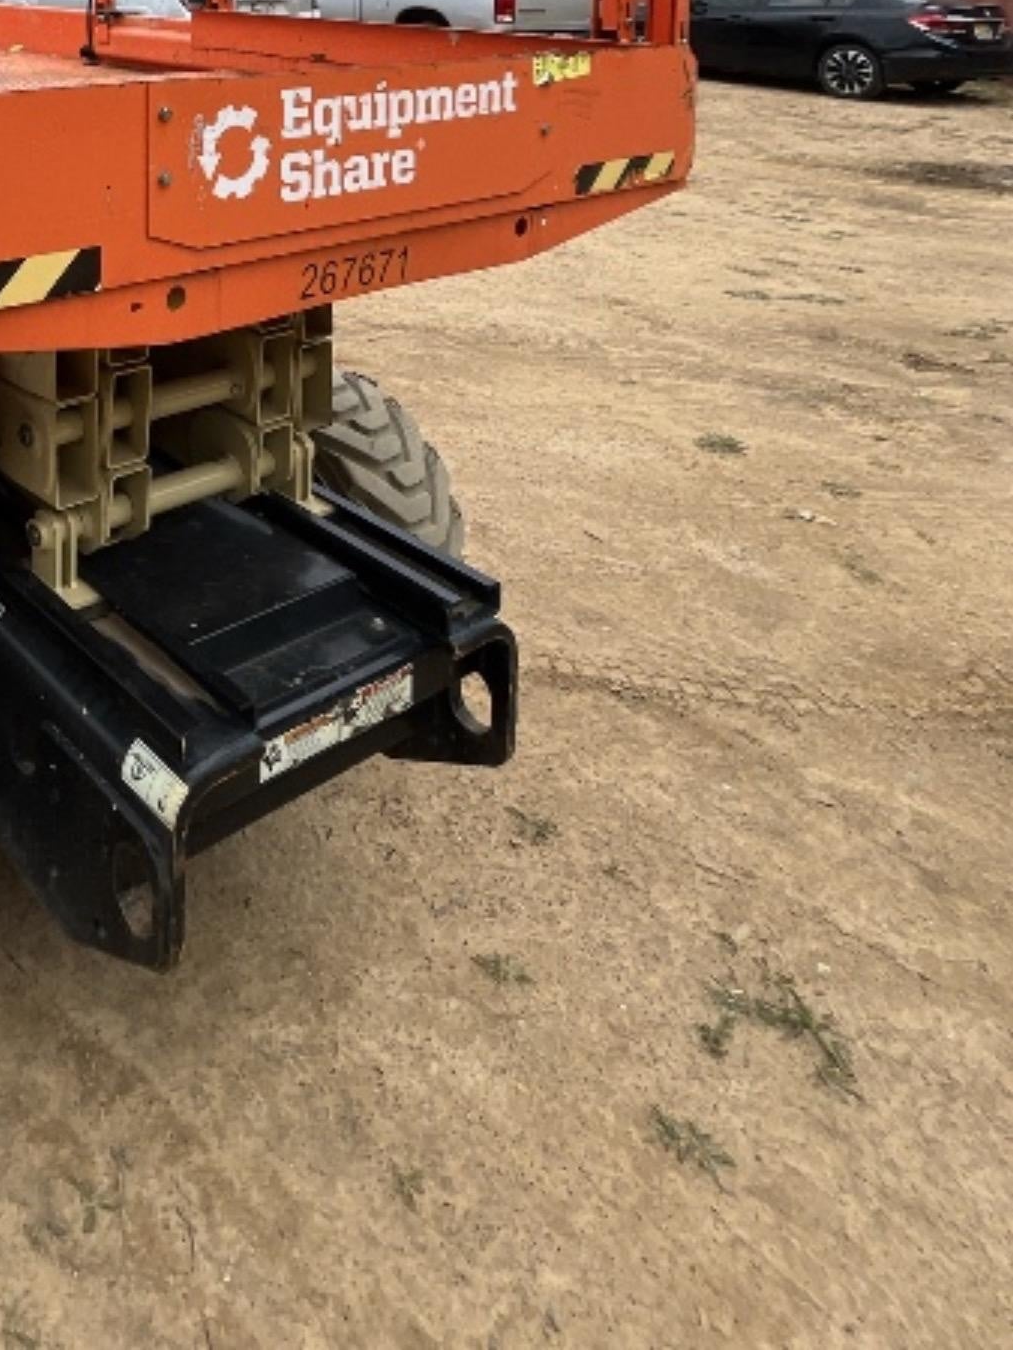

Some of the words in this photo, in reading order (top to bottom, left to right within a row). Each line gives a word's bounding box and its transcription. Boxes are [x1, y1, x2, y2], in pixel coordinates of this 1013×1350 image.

[280, 71, 519, 146] Equipment
[280, 148, 417, 202] Share
[300, 246, 409, 300] 267671
